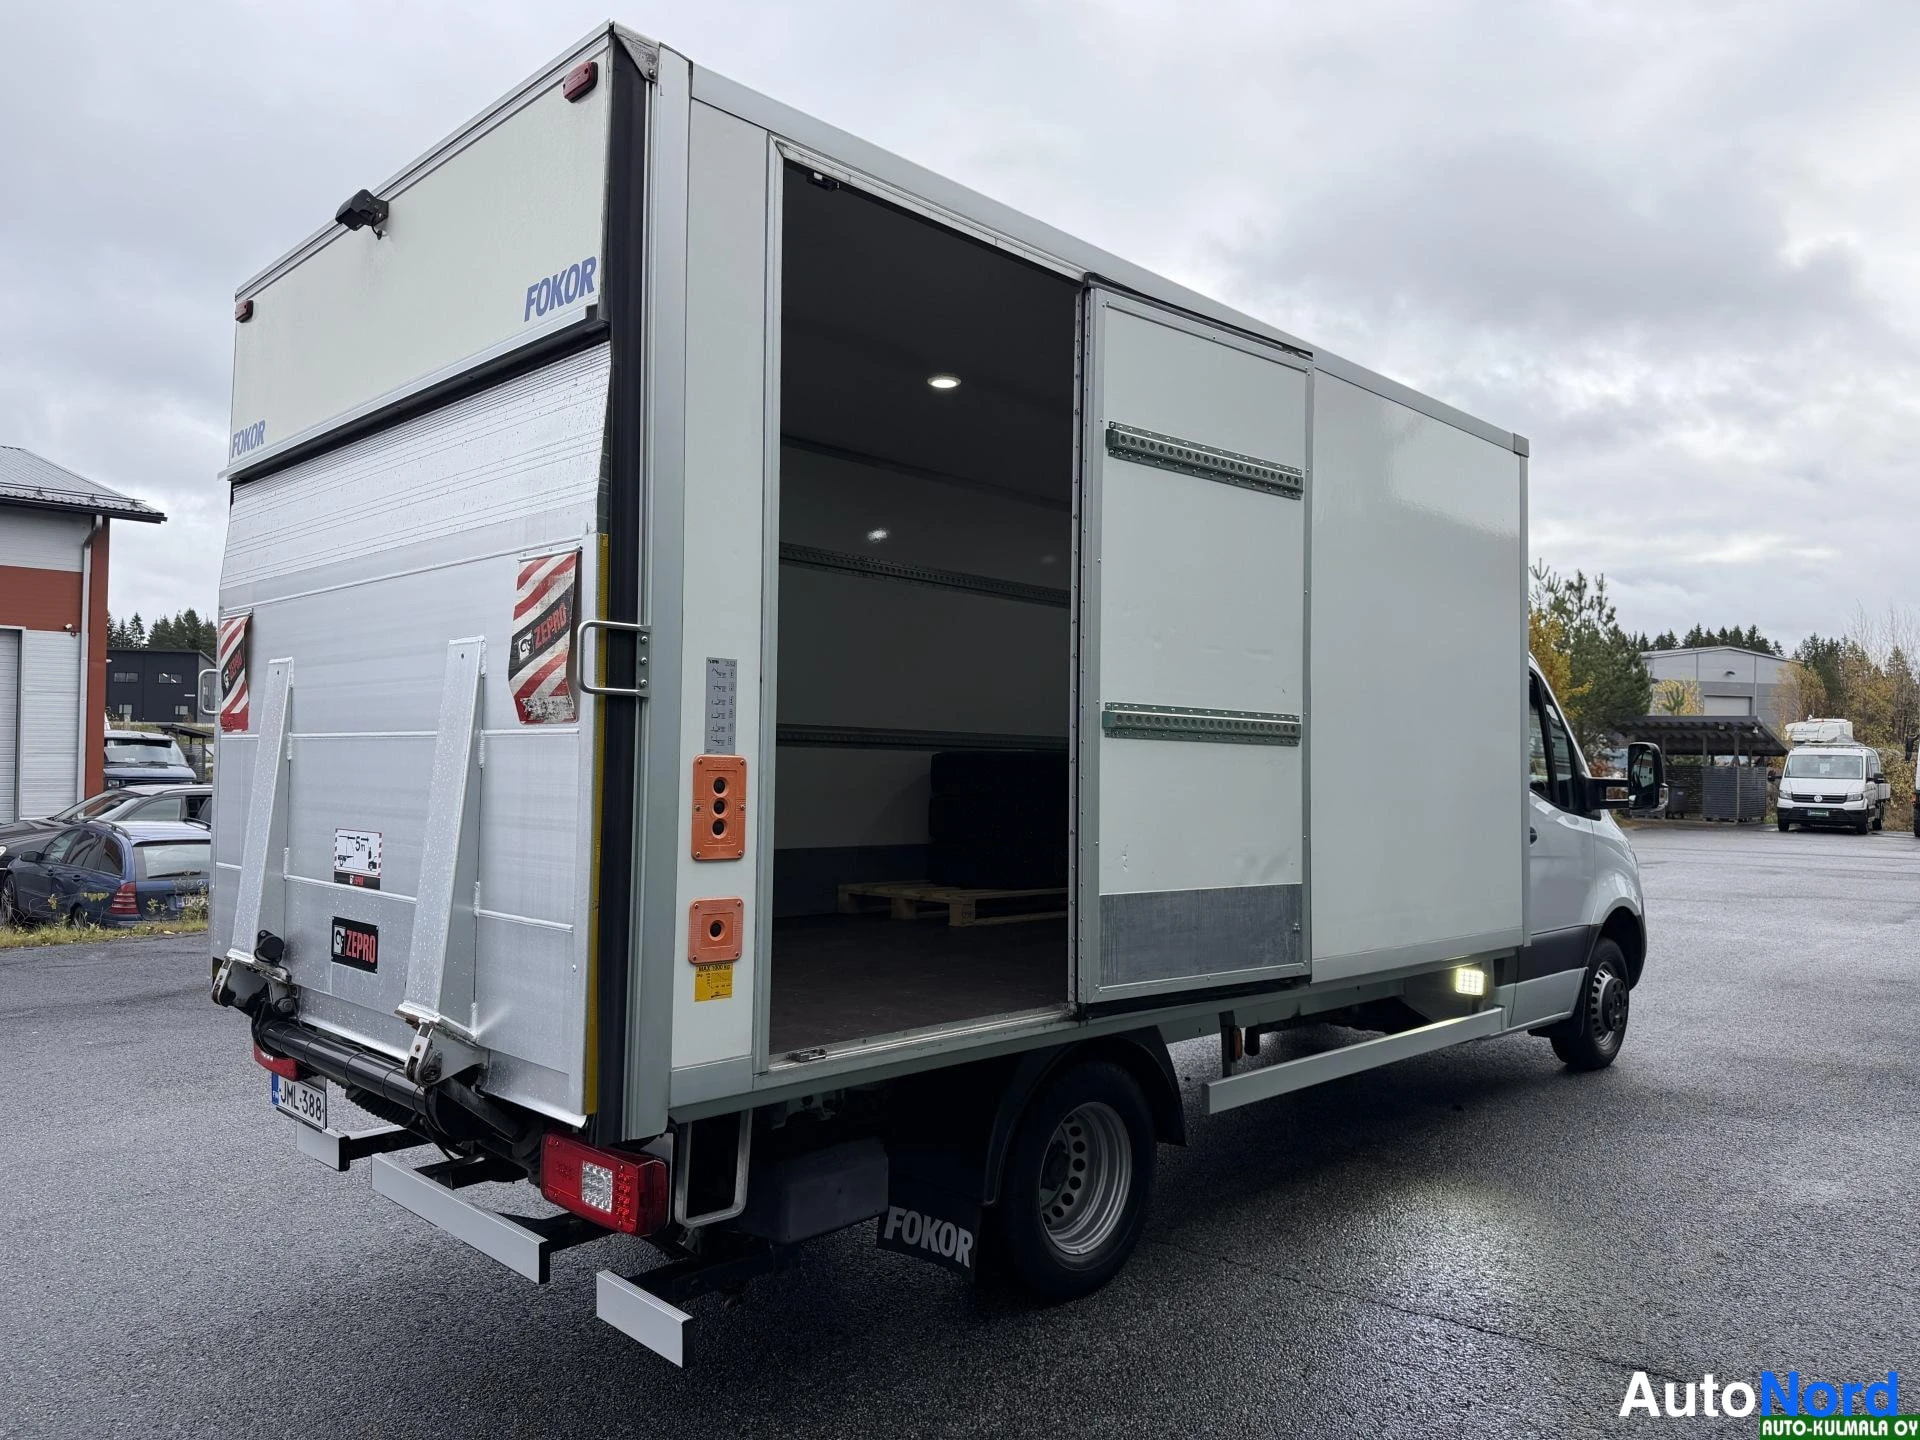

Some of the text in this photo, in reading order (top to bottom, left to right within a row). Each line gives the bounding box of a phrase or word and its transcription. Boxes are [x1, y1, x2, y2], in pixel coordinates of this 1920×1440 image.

[524, 256, 597, 322] FOKOR
[232, 420, 266, 457] FOKOR
[534, 602, 567, 650] ZEPRO
[345, 930, 376, 964] ZEPRO
[281, 1081, 322, 1121] JML-388
[884, 1205, 974, 1269] FOKOR
